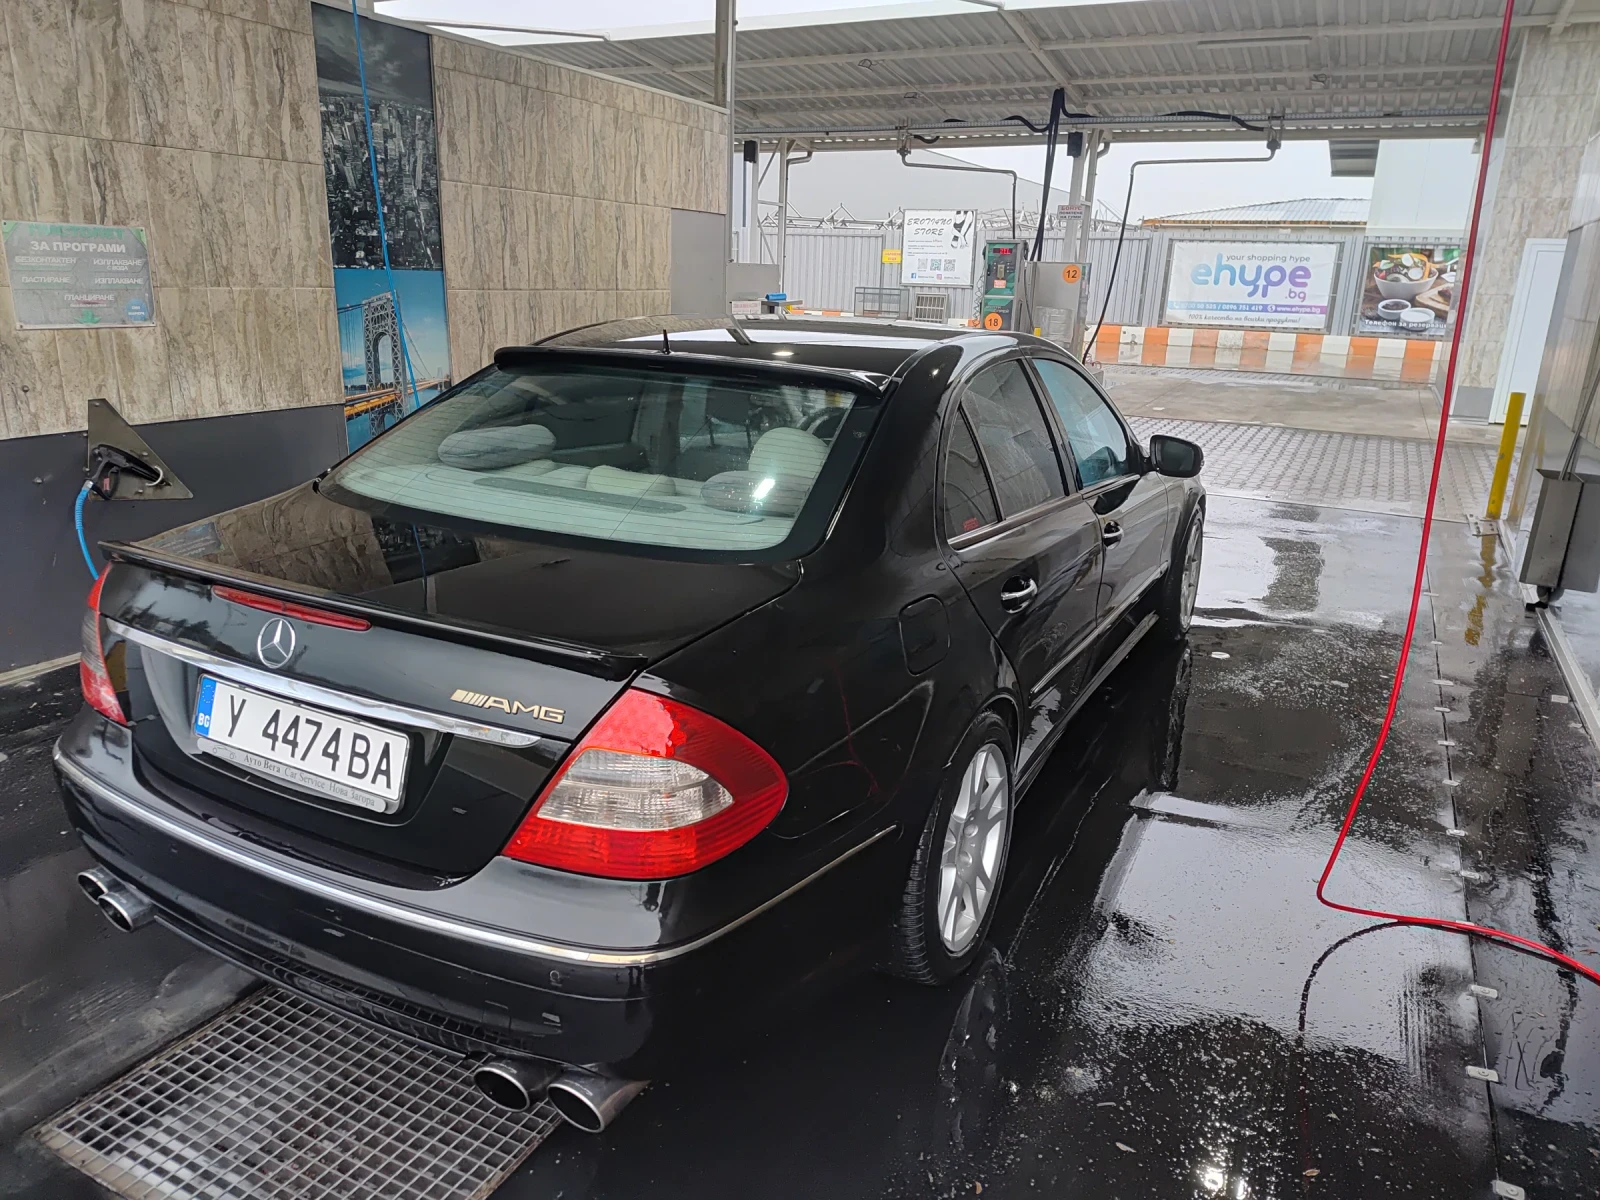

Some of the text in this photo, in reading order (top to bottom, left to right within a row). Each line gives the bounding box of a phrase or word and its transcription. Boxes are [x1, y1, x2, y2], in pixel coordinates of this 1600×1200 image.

[30, 241, 126, 253] ЗА ПРОГРАМИ
[1226, 254, 1311, 263] your shopping hype
[1065, 270, 1077, 279] 12
[1190, 253, 1311, 298] ehype
[1277, 305, 1321, 313] www.ehype.bg
[988, 318, 999, 327] 18
[1365, 319, 1397, 327] Телефон
[484, 696, 566, 724] AMG
[198, 712, 210, 728] BG
[284, 768, 297, 779] Car
[299, 772, 325, 789] Service
[329, 782, 348, 797] Нова
[350, 789, 375, 807] Загора
